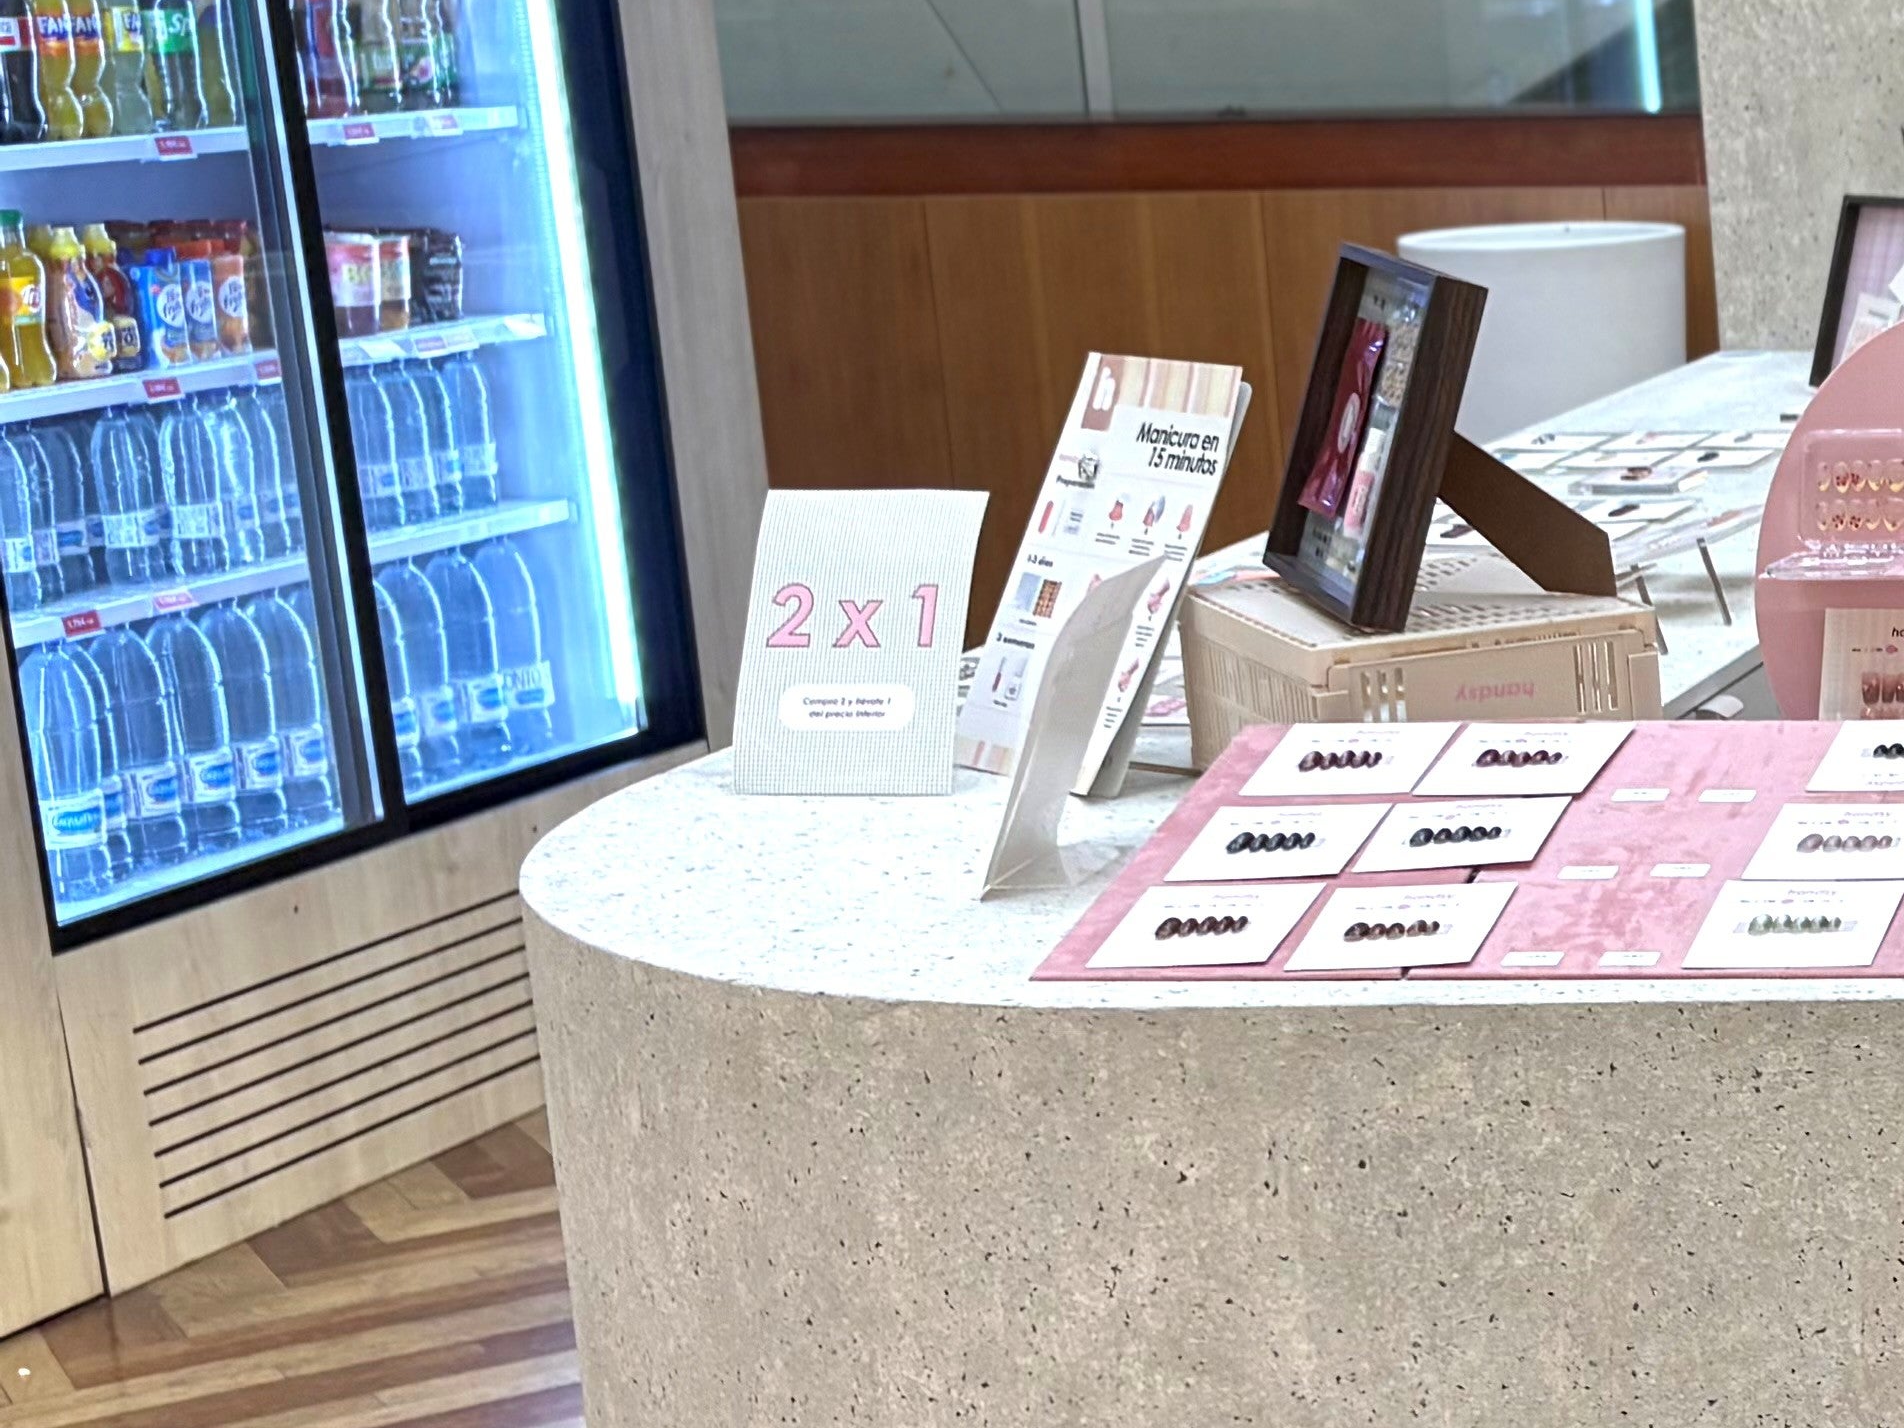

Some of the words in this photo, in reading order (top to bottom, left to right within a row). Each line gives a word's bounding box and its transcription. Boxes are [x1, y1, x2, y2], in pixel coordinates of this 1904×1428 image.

[1136, 421, 1200, 451] Manicura
[1201, 433, 1220, 453] en
[1148, 445, 1164, 469] 15
[1165, 448, 1219, 477] minutos
[766, 582, 815, 649] 2
[831, 599, 884, 649] x
[911, 583, 940, 649] 1
